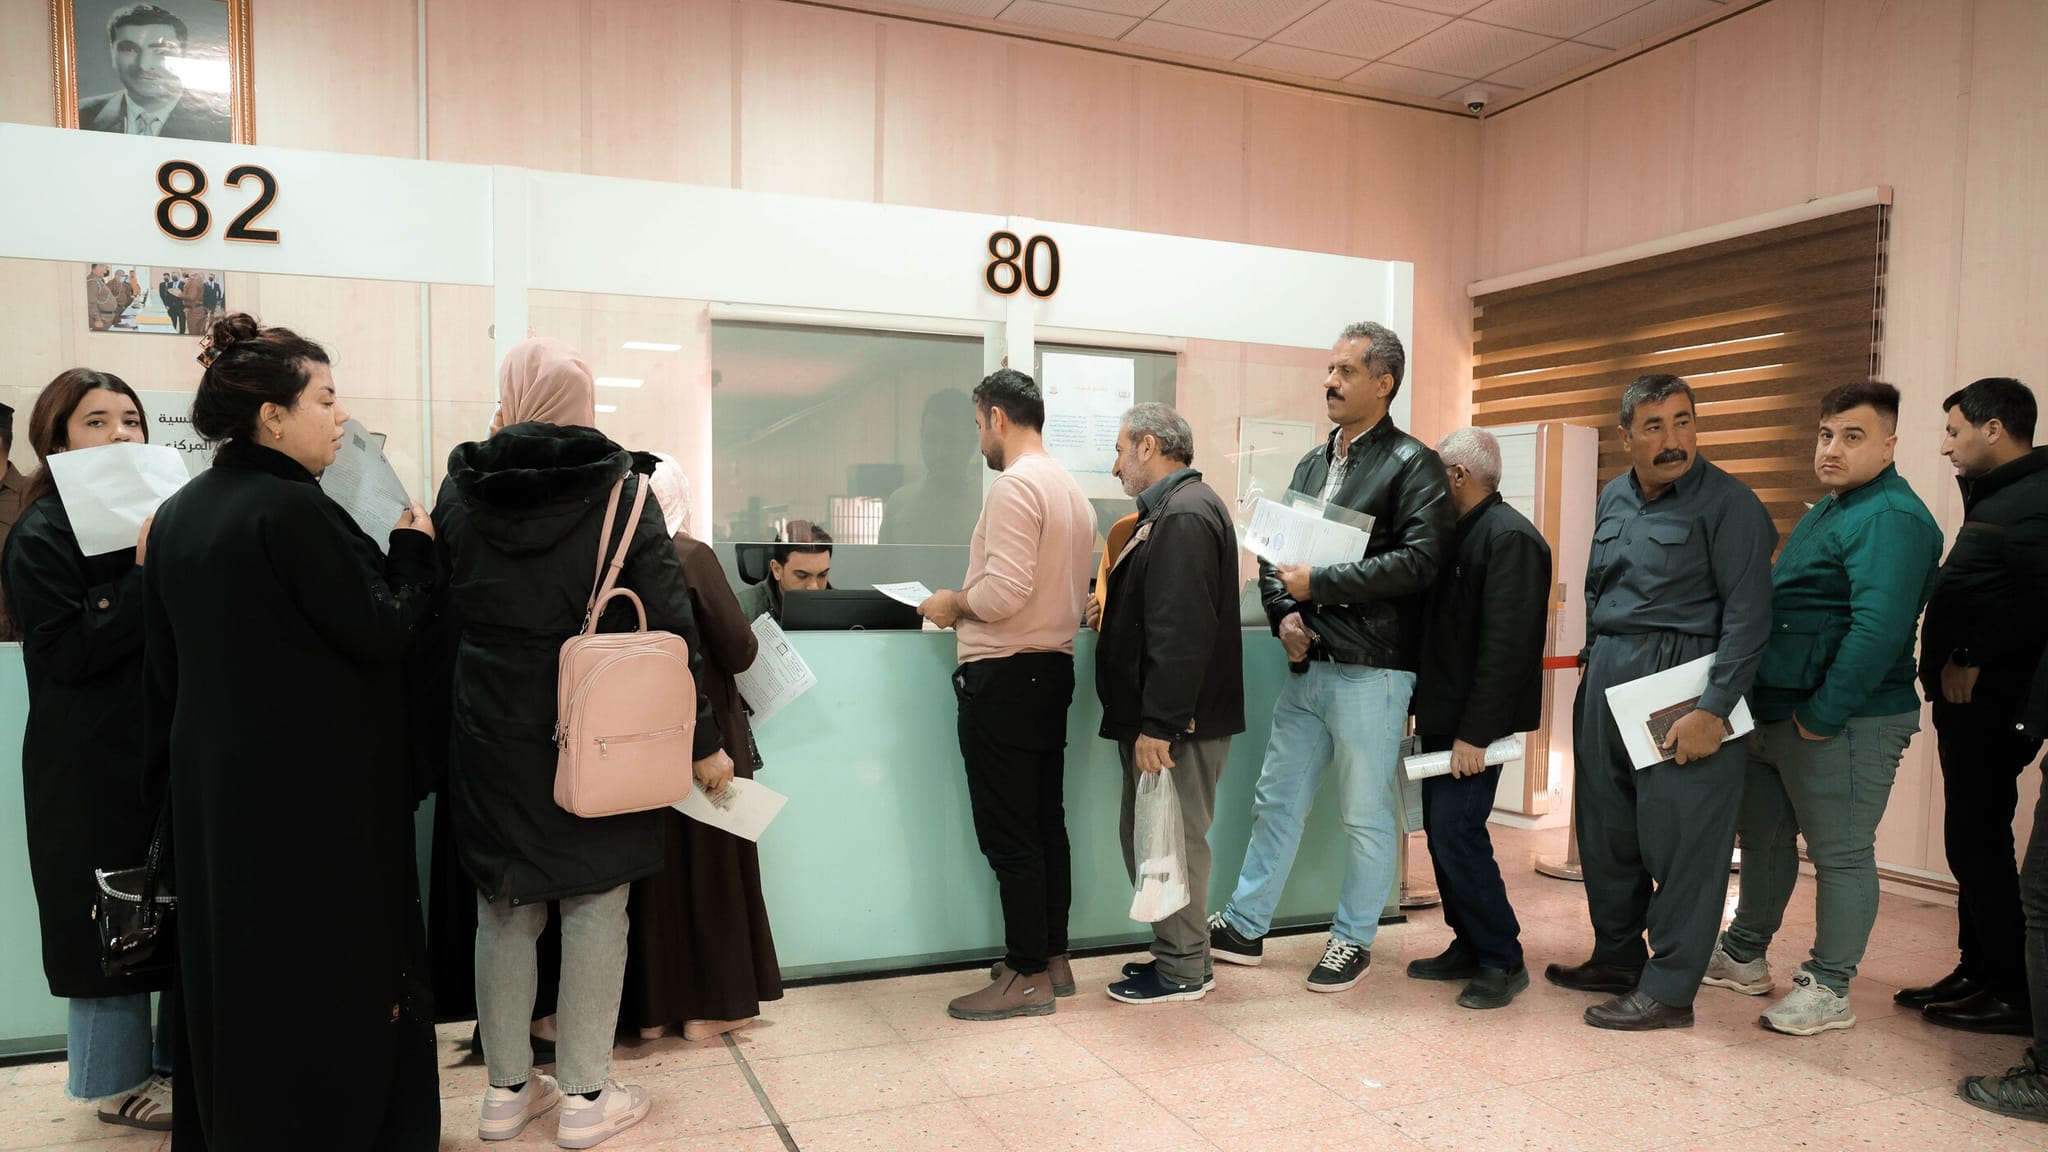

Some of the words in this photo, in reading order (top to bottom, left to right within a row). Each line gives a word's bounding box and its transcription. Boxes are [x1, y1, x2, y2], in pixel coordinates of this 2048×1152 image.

[154, 159, 280, 244] 82
[984, 230, 1062, 300] 80
[158, 413, 193, 426] سية
